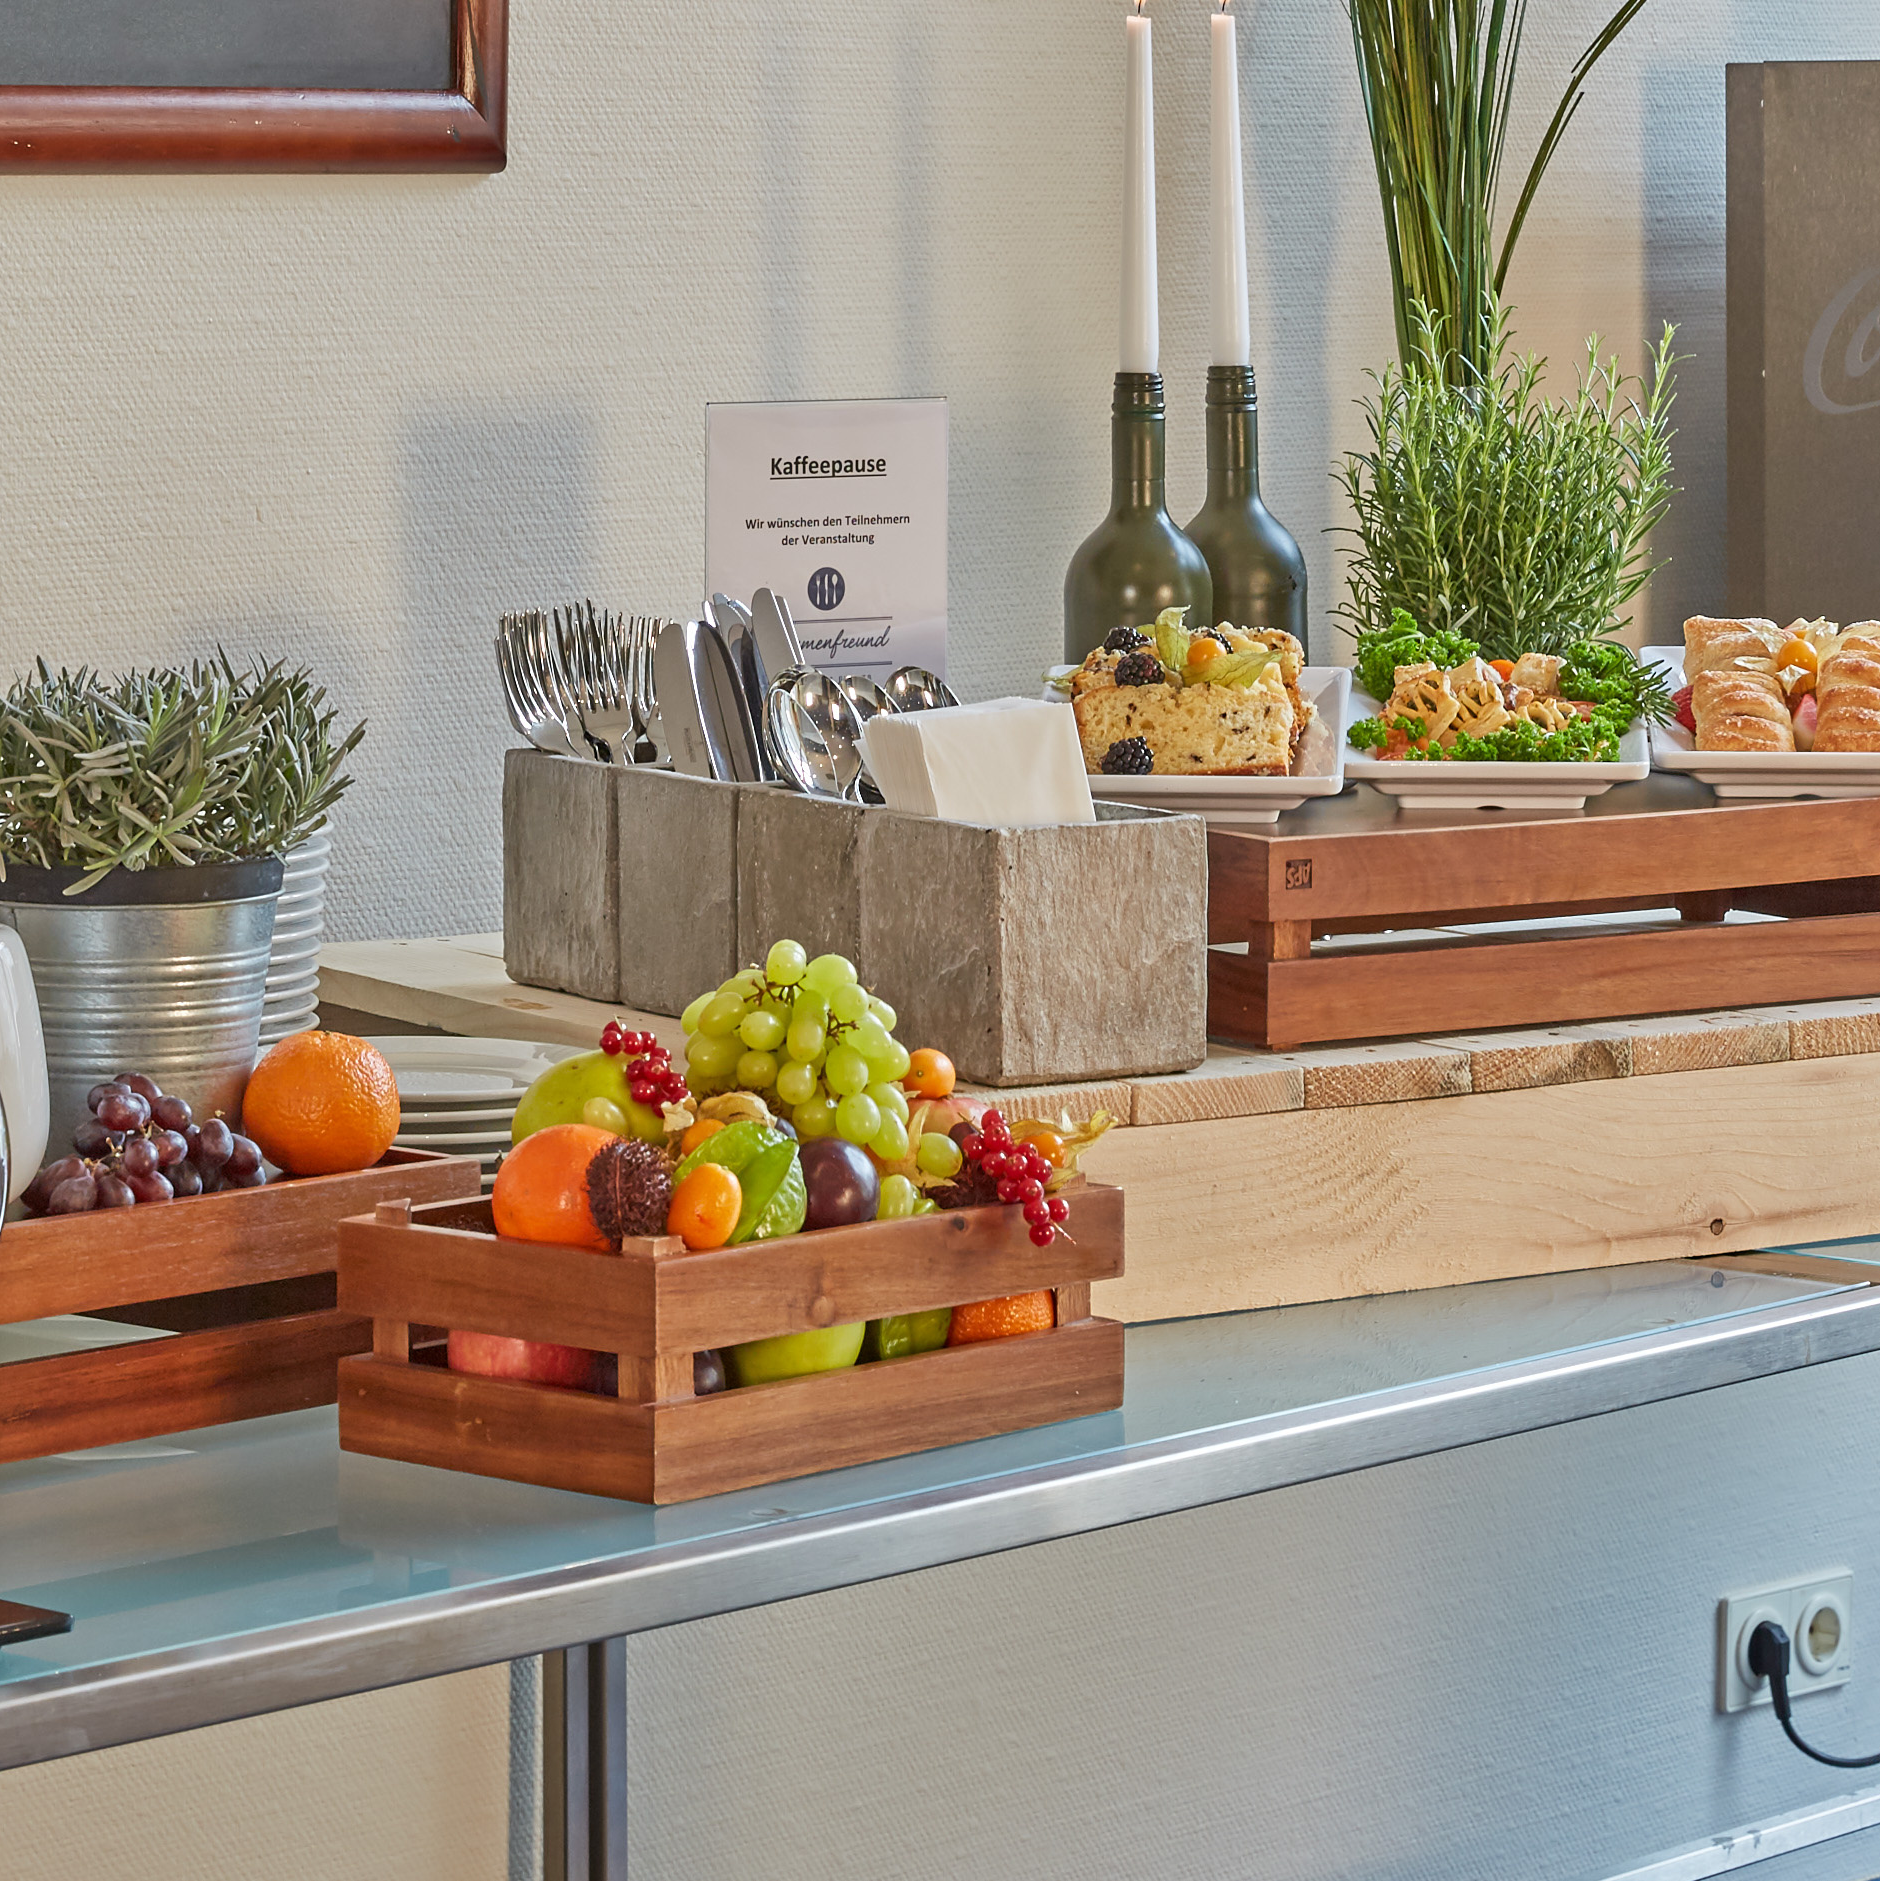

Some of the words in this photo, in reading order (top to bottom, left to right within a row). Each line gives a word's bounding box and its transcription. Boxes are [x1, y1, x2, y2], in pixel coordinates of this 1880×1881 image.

[770, 455, 887, 478] Kaffeepause
[745, 518, 764, 529] Wir
[767, 517, 819, 529] wünschen
[822, 516, 842, 527] den
[845, 514, 910, 526] Teilnehmern
[781, 535, 799, 546] der
[802, 533, 875, 545] Veranstaltung
